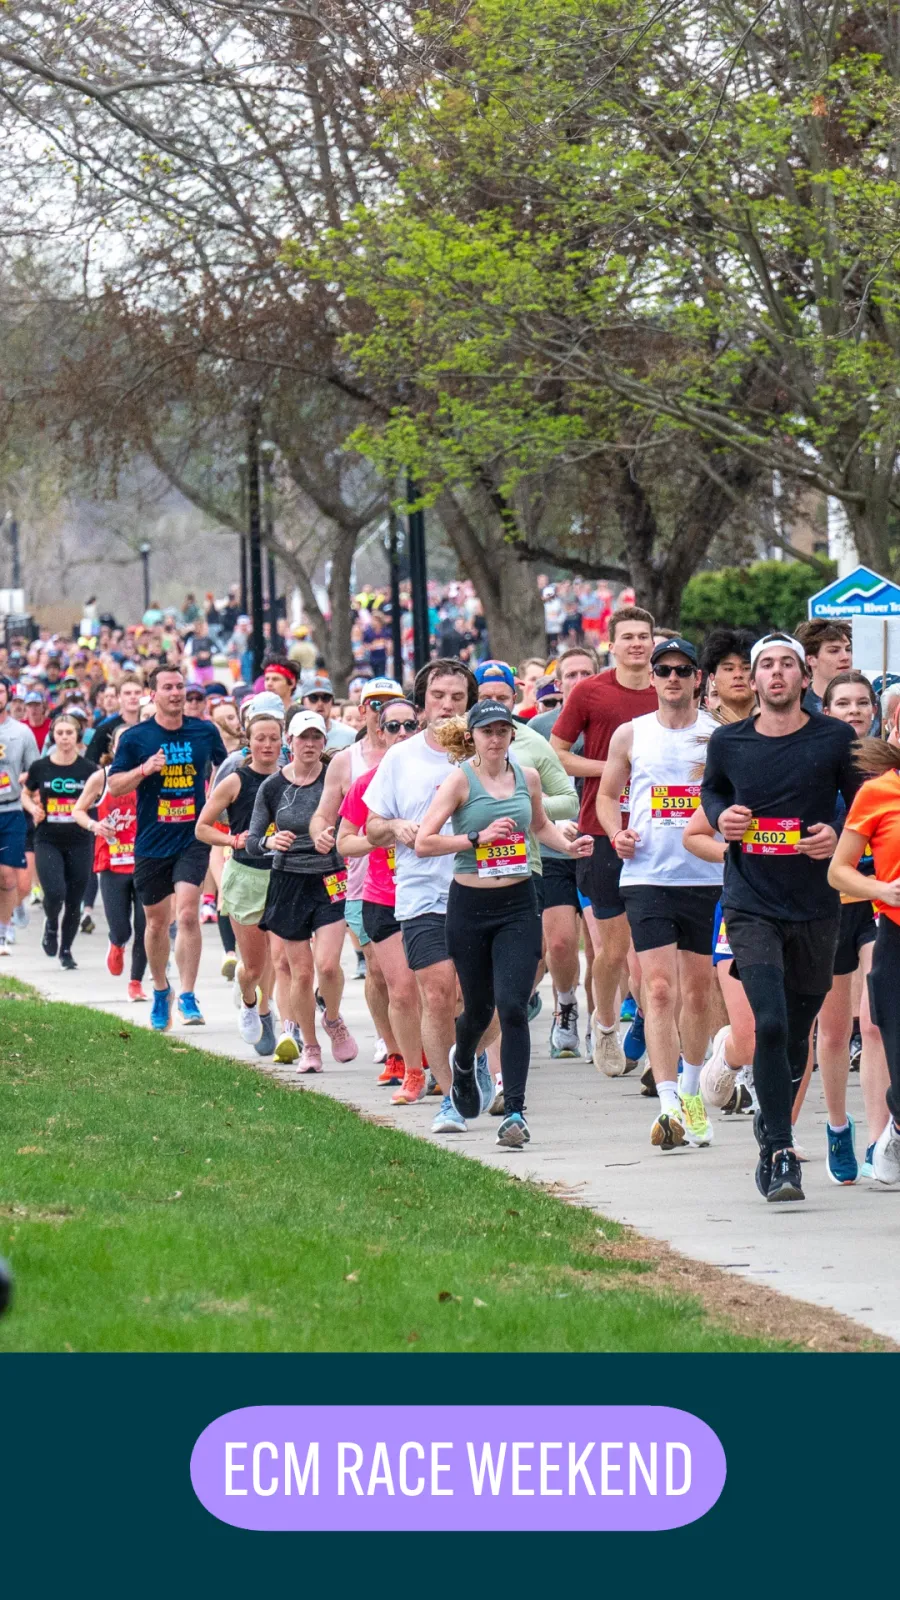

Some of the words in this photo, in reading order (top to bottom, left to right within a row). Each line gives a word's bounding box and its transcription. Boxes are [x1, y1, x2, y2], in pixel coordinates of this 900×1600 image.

[814, 604, 861, 615] Chippewa
[863, 603, 888, 613] River
[160, 741, 192, 754] TALK
[164, 753, 193, 764] LESS
[160, 764, 184, 776] RUN
[163, 775, 194, 788] MORE
[662, 797, 693, 808] 5191
[167, 807, 188, 816] 3566
[753, 831, 787, 844] 4602
[487, 845, 517, 858] 3335
[335, 880, 348, 892] 35
